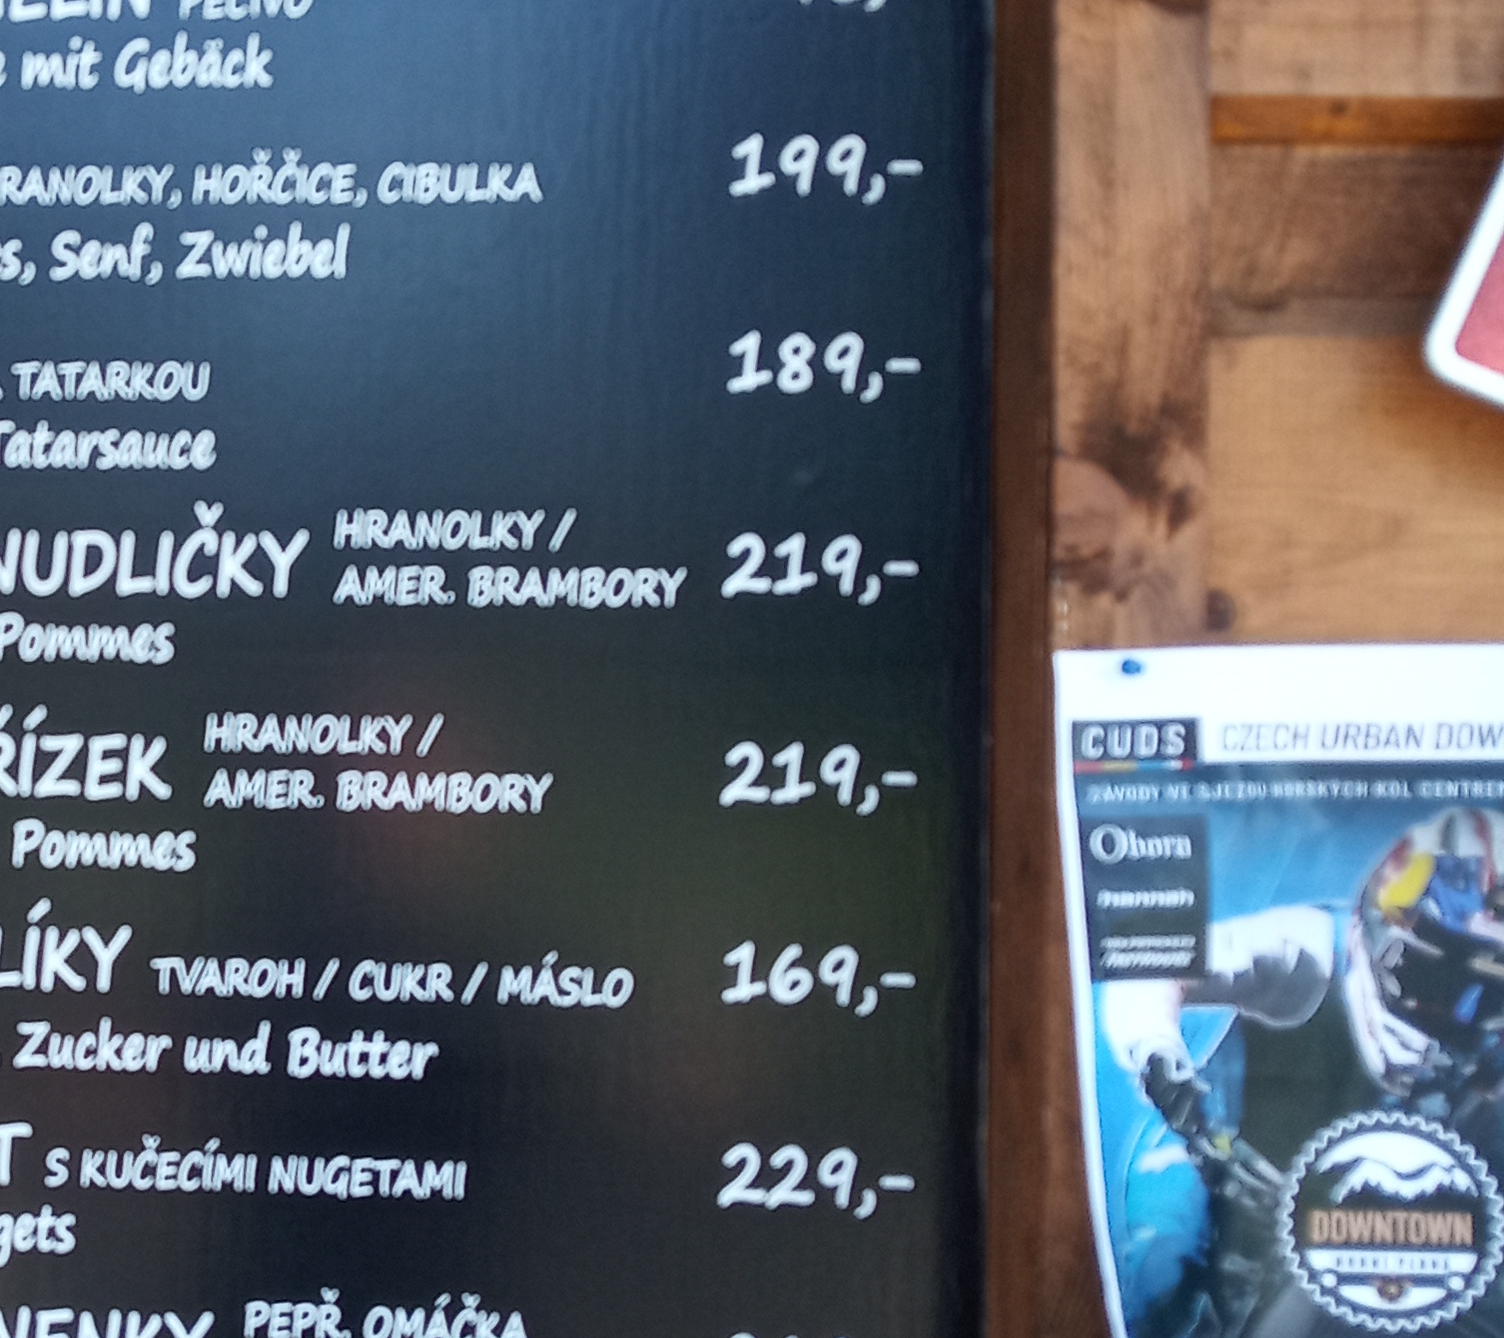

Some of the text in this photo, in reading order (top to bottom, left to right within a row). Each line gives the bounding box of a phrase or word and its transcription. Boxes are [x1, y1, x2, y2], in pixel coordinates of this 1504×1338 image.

[20, 35, 102, 90] mit
[113, 30, 273, 94] Gebäck
[191, 147, 369, 208] HOŘČICE,
[375, 160, 543, 206] CIBULKA
[729, 133, 923, 205] 199,-
[48, 221, 164, 286] Senf,
[175, 220, 351, 280] Zwiebel
[10, 359, 212, 402] TATARKOU
[727, 330, 921, 403] 189,-
[333, 508, 546, 551] HRANOLKY
[333, 564, 688, 609] AMER. BRAMBORY
[721, 532, 919, 605] 219,-
[203, 712, 413, 755] HRANOLKY
[1081, 725, 1186, 759] CUDS
[1222, 724, 1309, 752] CZECH
[1320, 723, 1423, 751] URBAN
[203, 768, 554, 814] AMER. BRAMBORY
[719, 741, 917, 815] 219,-
[11, 817, 196, 872] Pommes
[150, 956, 307, 999] TVAROH
[347, 958, 455, 1002] CUKR
[496, 950, 635, 1009] MÁSLO
[721, 940, 916, 1016] 169,-
[12, 1016, 173, 1072] Zucker
[183, 1020, 272, 1075] und
[286, 1026, 440, 1080] Butter
[44, 1147, 70, 1188] S
[79, 1134, 258, 1192] KUČECÍMI
[267, 1154, 468, 1199] NUGETAMI
[717, 1142, 915, 1219] 229,-
[1310, 1210, 1474, 1247] DOWNTOWN
